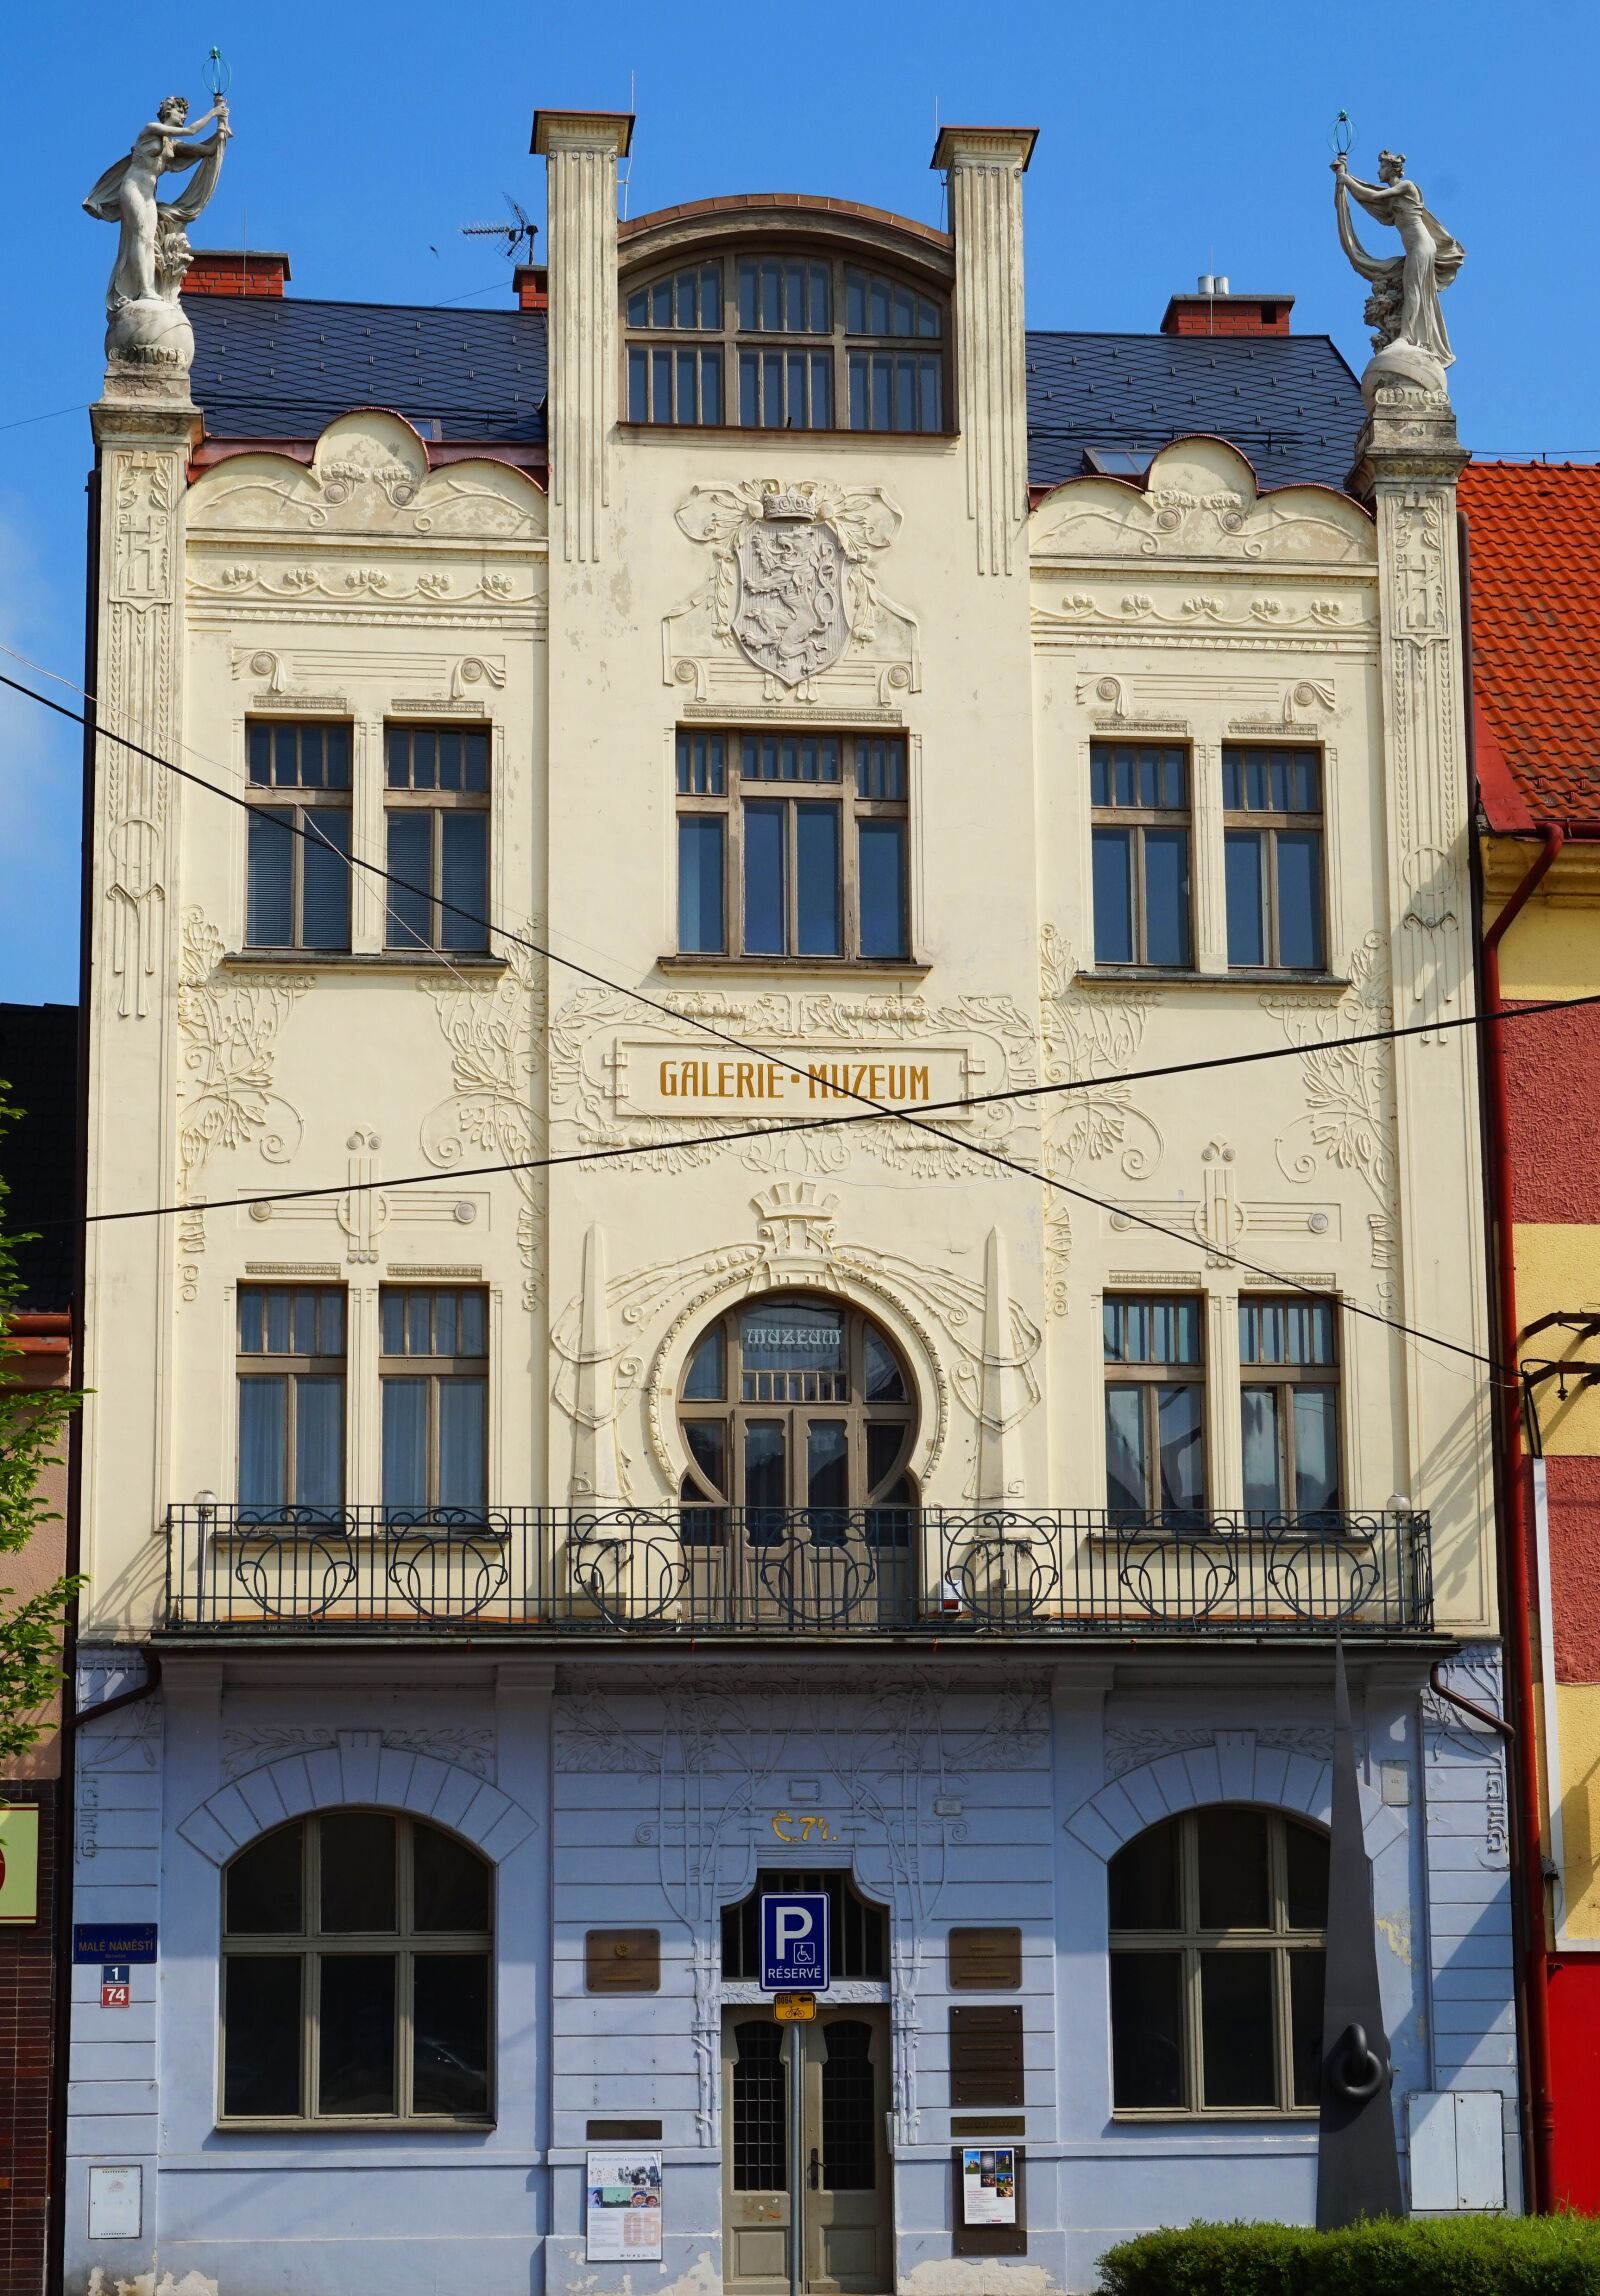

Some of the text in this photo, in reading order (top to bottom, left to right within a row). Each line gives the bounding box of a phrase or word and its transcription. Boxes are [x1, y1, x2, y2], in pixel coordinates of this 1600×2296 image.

[660, 1060, 930, 1101] GALERIE MUZEUM
[776, 1906, 813, 1960] P
[79, 1937, 153, 1952] MALÉ NÁMĚSTÍ
[111, 1967, 119, 1980] 1
[768, 1965, 822, 1979] RÉSERVÉ
[107, 1988, 126, 2002] 74
